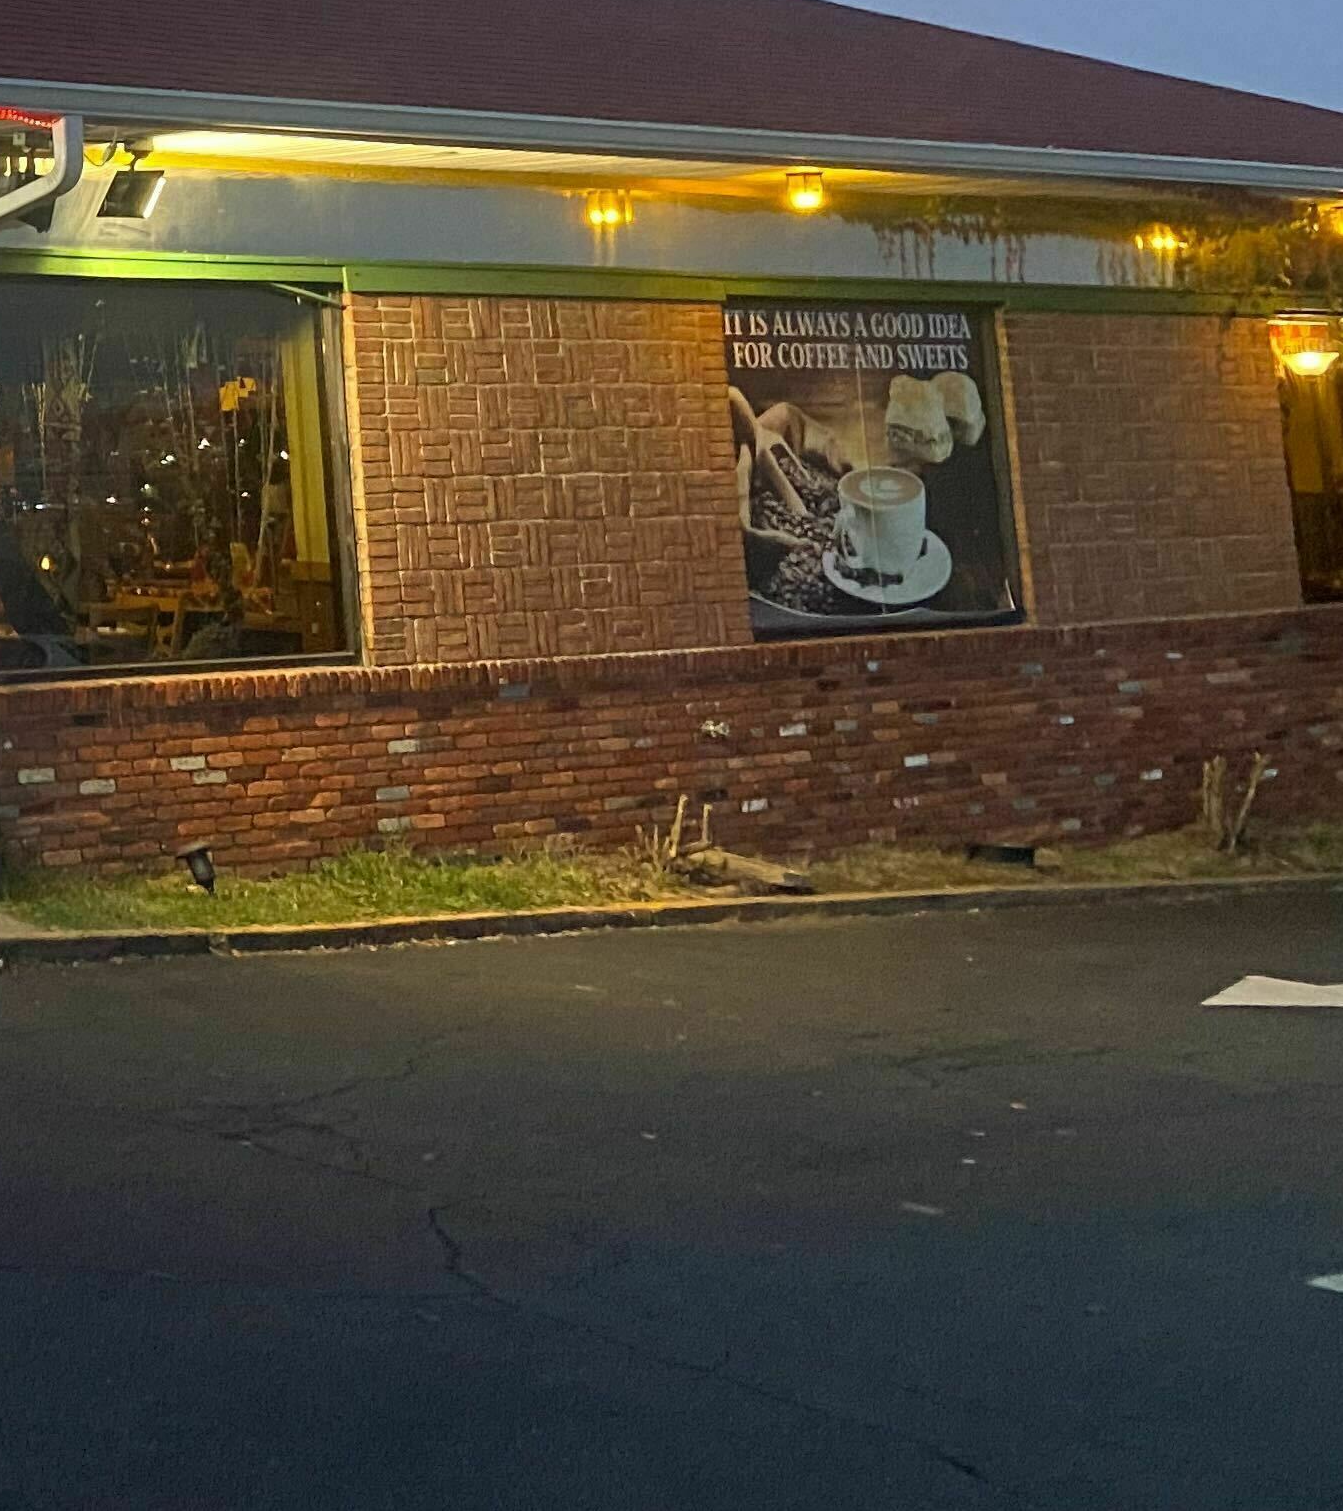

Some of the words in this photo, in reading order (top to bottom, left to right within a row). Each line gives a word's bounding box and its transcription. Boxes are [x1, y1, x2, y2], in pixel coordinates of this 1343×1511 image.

[749, 311, 768, 336] IS
[772, 311, 850, 339] ALWAYS
[854, 313, 868, 339] A
[870, 312, 923, 340] GOOD
[928, 313, 971, 340] IDEA
[733, 341, 775, 369] FOR
[777, 342, 850, 370] COFFEE
[854, 343, 893, 370] AND
[896, 343, 969, 370] SWEETS
